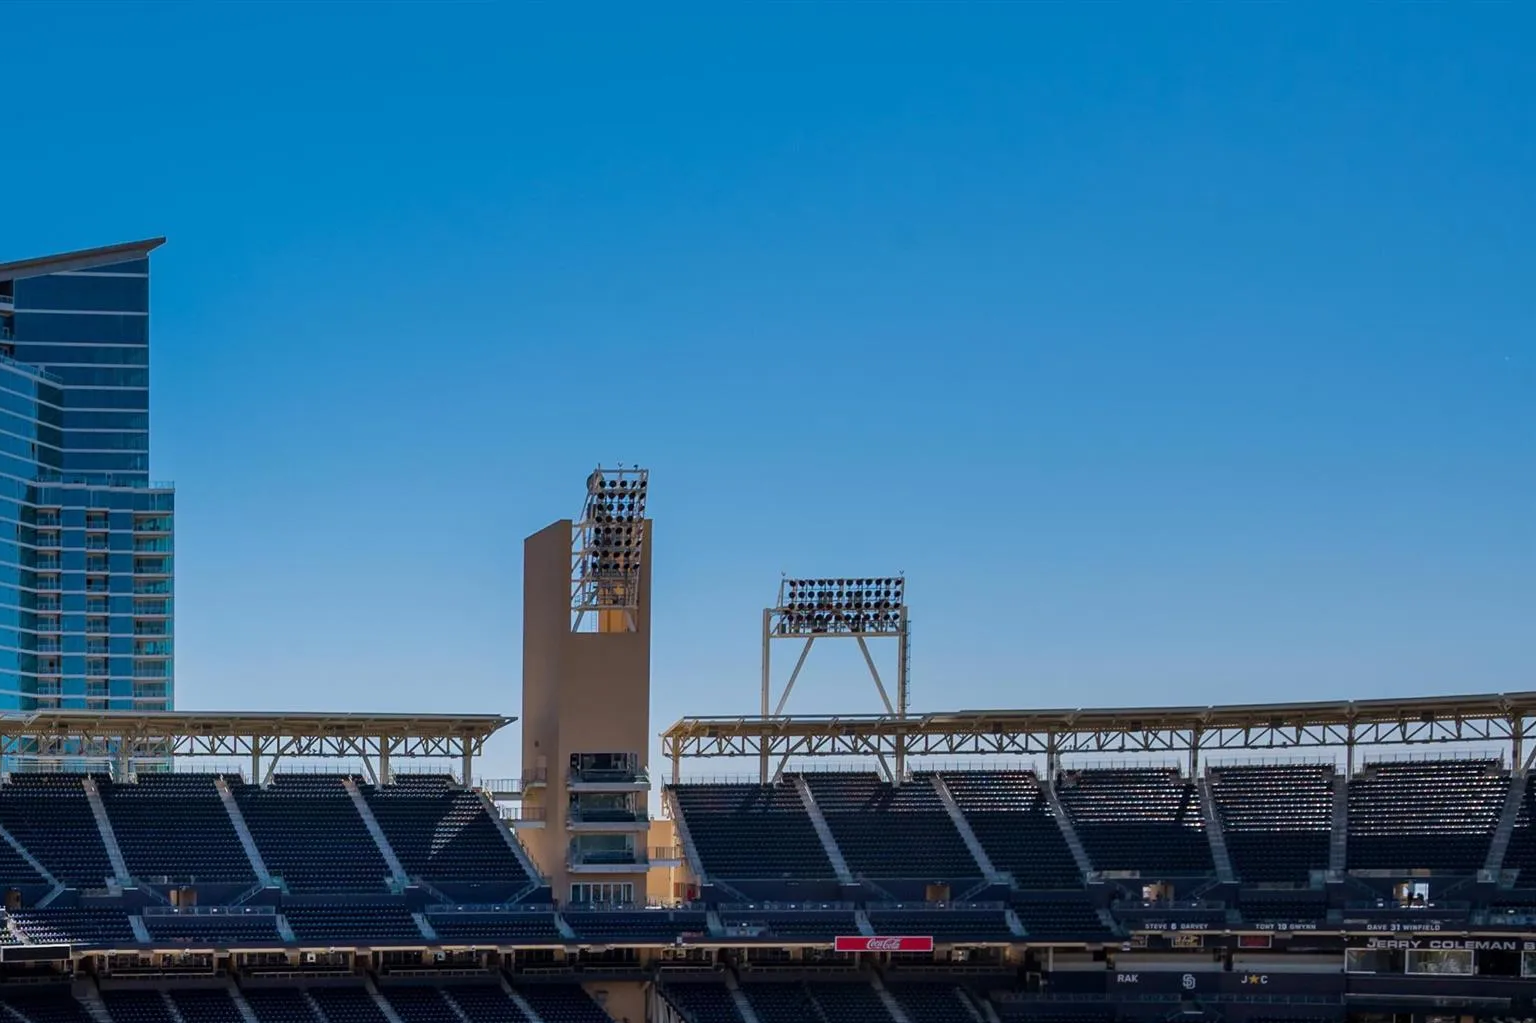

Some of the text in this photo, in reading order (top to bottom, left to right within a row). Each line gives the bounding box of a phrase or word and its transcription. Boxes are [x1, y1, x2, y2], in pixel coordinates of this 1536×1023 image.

[1390, 923, 1400, 931] 31
[1367, 938, 1421, 949] JERRY
[1430, 940, 1516, 950] COLEMAN
[1117, 974, 1139, 983] RAK
